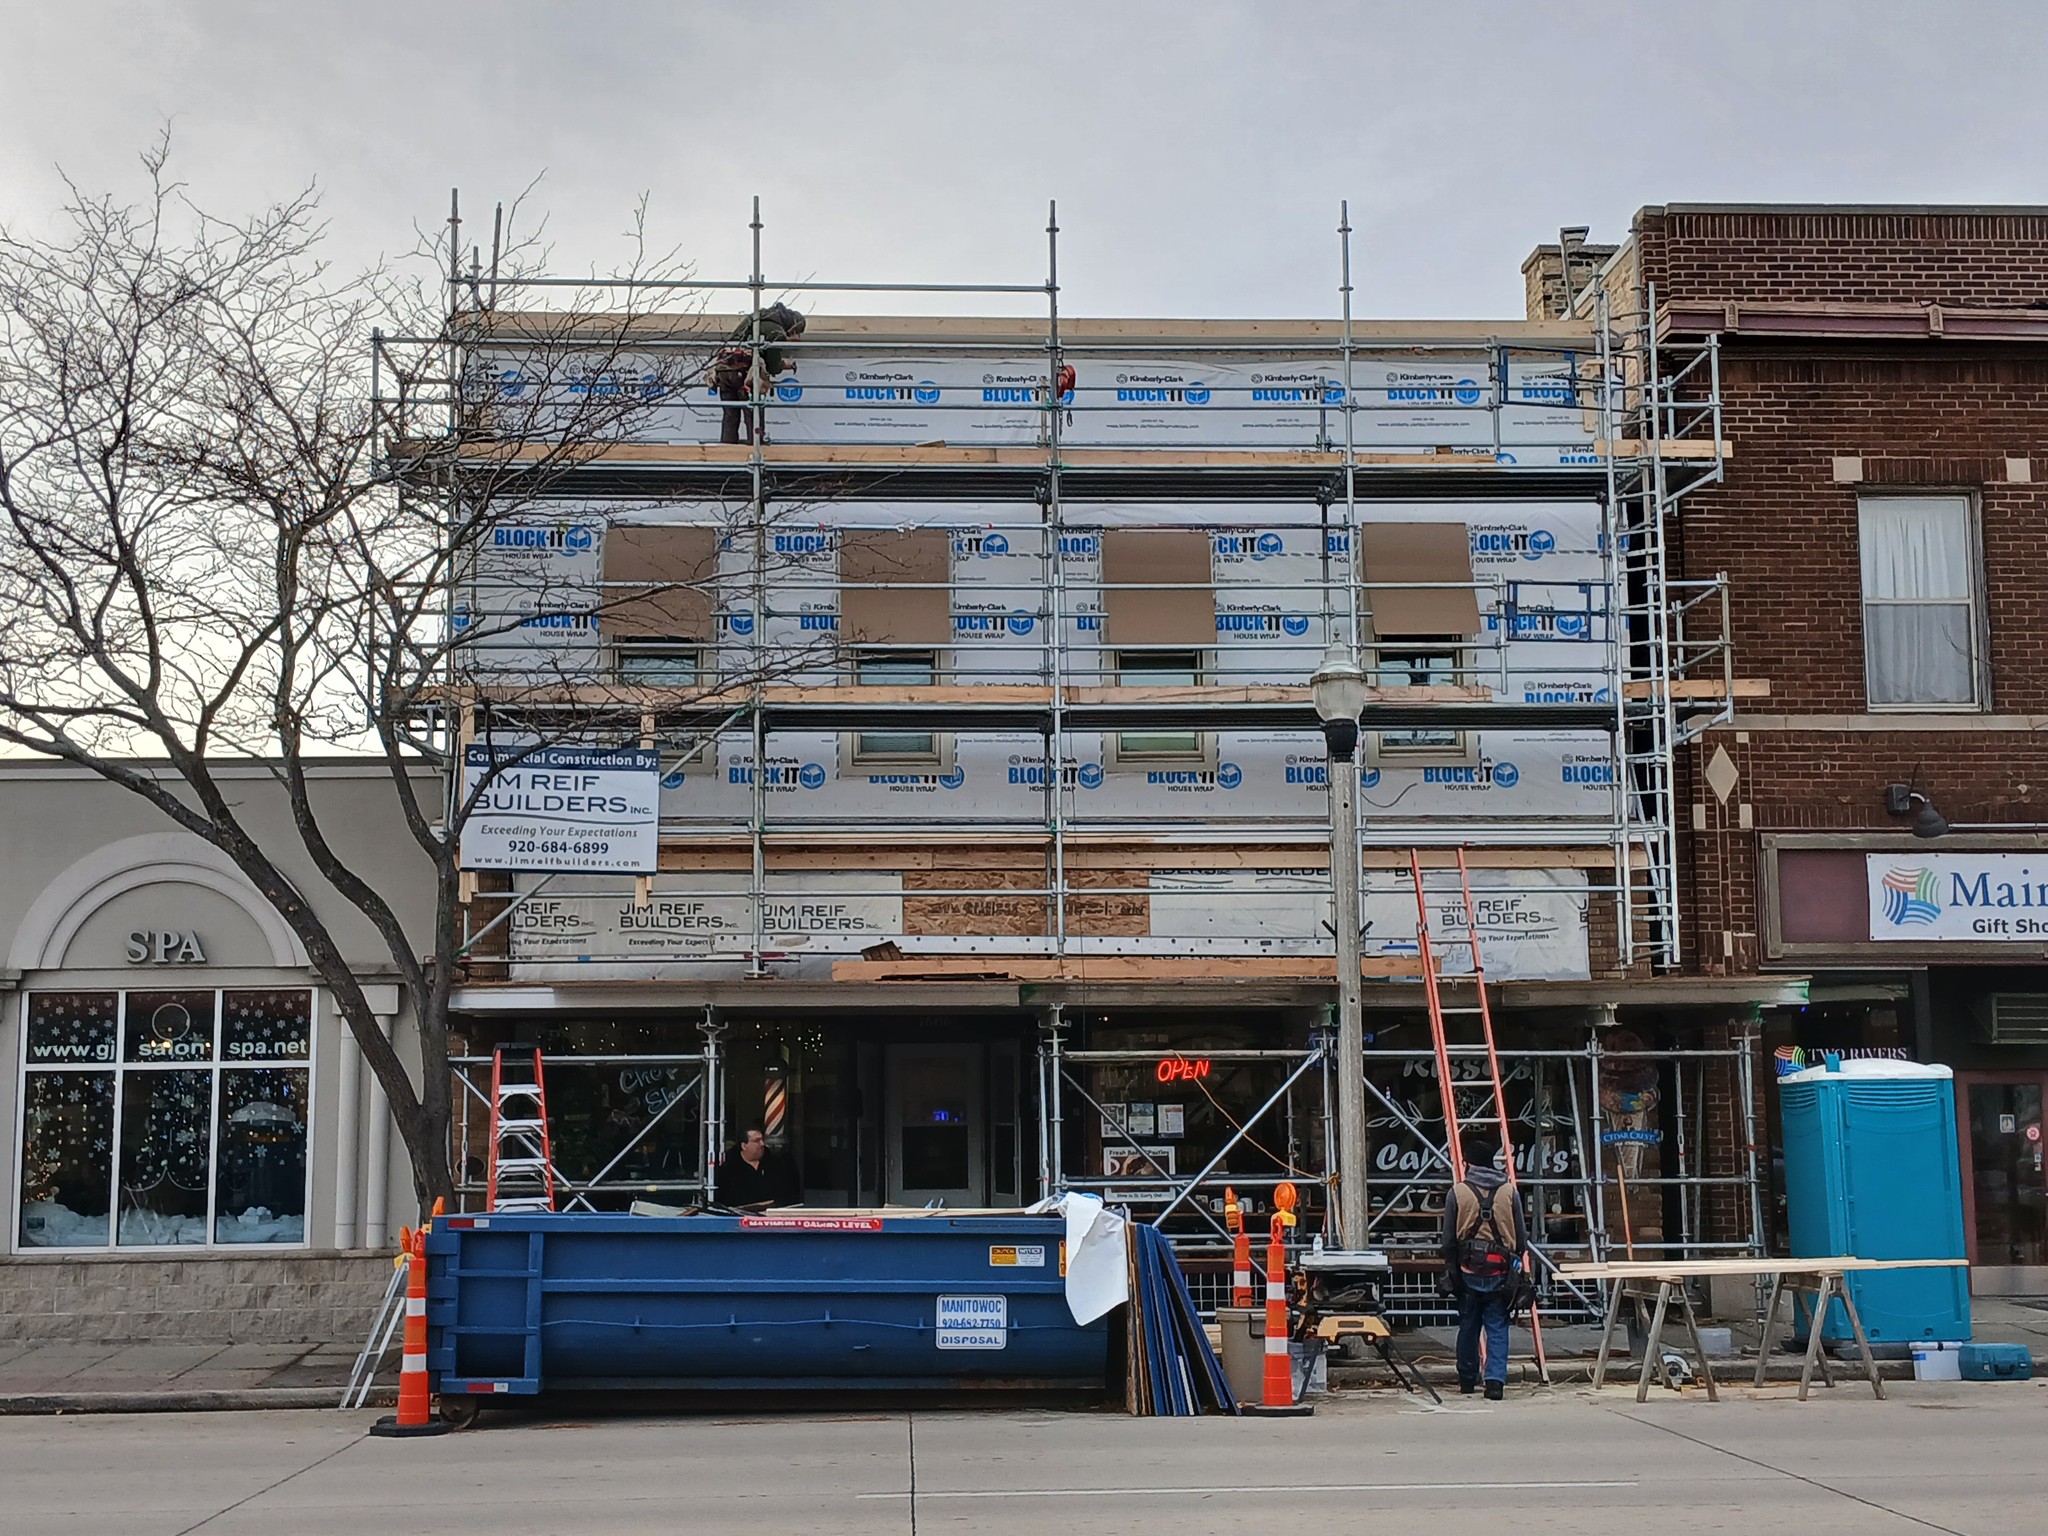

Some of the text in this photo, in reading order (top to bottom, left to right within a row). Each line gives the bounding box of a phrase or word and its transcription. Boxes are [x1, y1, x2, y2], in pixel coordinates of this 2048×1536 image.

[550, 753, 634, 766] Construction
[637, 754, 656, 768] By:
[531, 774, 600, 791] REIF
[473, 793, 627, 813] BUILDERS
[481, 825, 638, 840] Exceeding Your Expectations
[509, 840, 609, 854] 920-684-6899
[474, 856, 640, 867] www.jimreifbuilders.com
[516, 902, 561, 915] REIF
[659, 903, 705, 915] REIF
[764, 905, 846, 917] JIM REIF
[1479, 900, 1521, 912] REIF
[620, 916, 724, 929] BUILDERS
[764, 917, 865, 930] BUILDERS
[1972, 918, 2009, 934] Gift
[125, 929, 206, 964] SPA
[33, 1041, 116, 1060] www.gj
[227, 1038, 307, 1056] spa.net
[1849, 1047, 1907, 1060] RIVERS
[1157, 1059, 1211, 1083] OPEN
[842, 1221, 873, 1229] LEVEL
[942, 1299, 1002, 1313] MANITOWOC
[941, 1336, 1001, 1344] DISPOSAL
